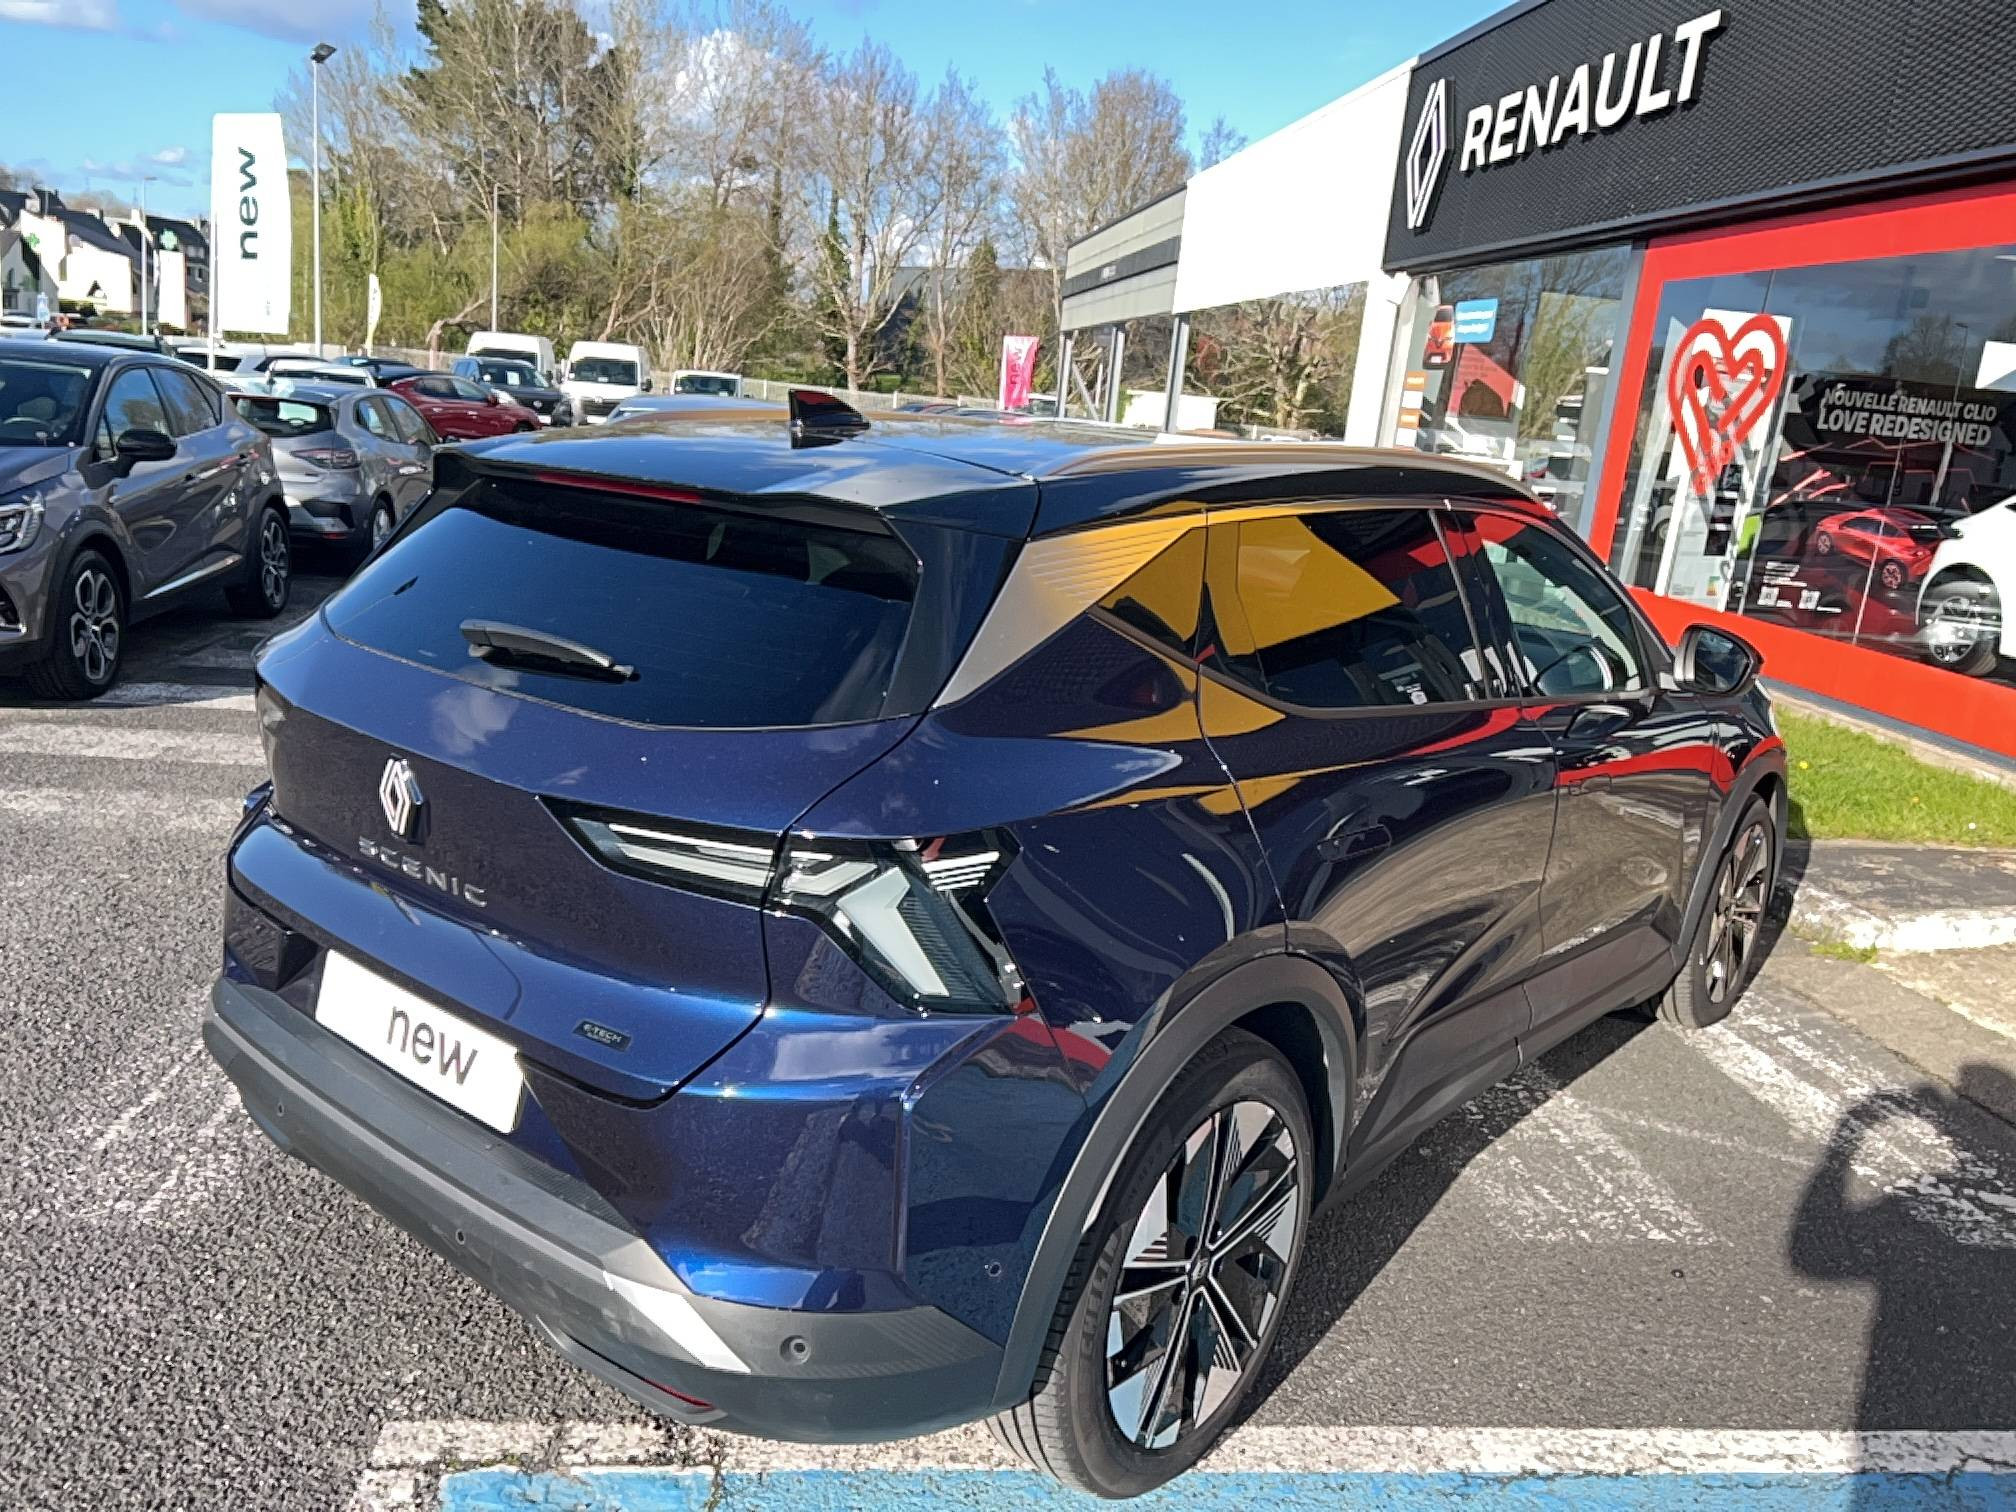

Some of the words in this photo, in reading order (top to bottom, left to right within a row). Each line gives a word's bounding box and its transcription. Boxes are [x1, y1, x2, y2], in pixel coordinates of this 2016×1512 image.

[1459, 9, 1722, 172] RENAULT
[238, 147, 259, 260] new
[1817, 403, 1870, 433] LOVE
[1869, 413, 1993, 446] REDESIGNED
[1823, 386, 1899, 412] NOUVELLE
[1898, 396, 1963, 418] RENAULT
[1963, 402, 1998, 422] CLIO
[358, 835, 488, 908] SCENIC
[387, 1005, 479, 1086] new
